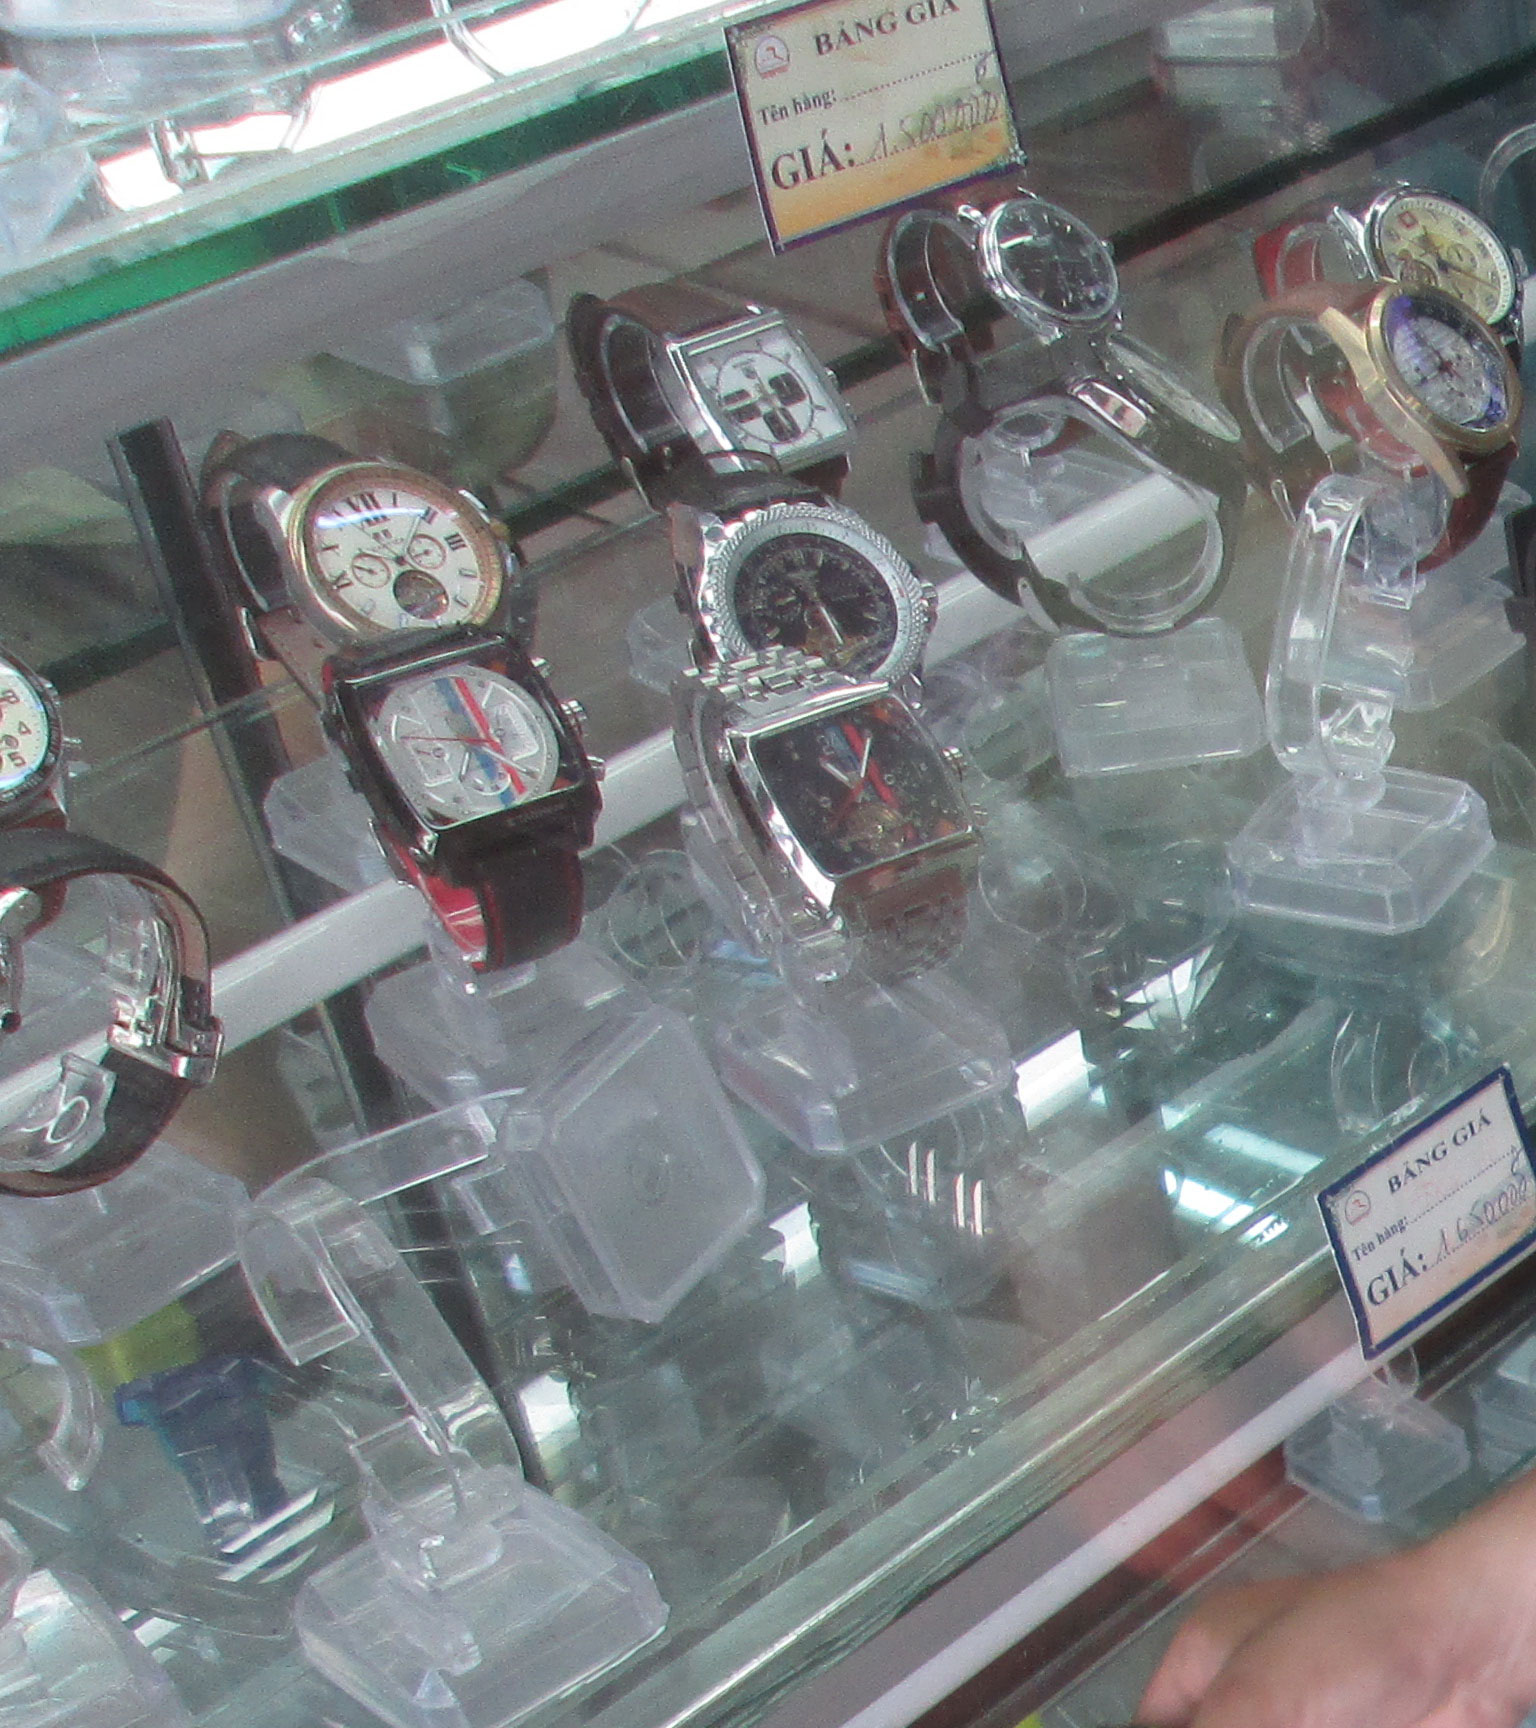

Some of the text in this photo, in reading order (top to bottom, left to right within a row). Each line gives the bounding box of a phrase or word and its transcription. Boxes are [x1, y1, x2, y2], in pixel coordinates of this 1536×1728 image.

[759, 89, 837, 127] Tên hàng:
[771, 128, 855, 191] GIÁ:
[1451, 1108, 1492, 1148] GIÁ
[1351, 1216, 1410, 1262] Tên hàng:
[1367, 1248, 1428, 1307] GIÁ:
